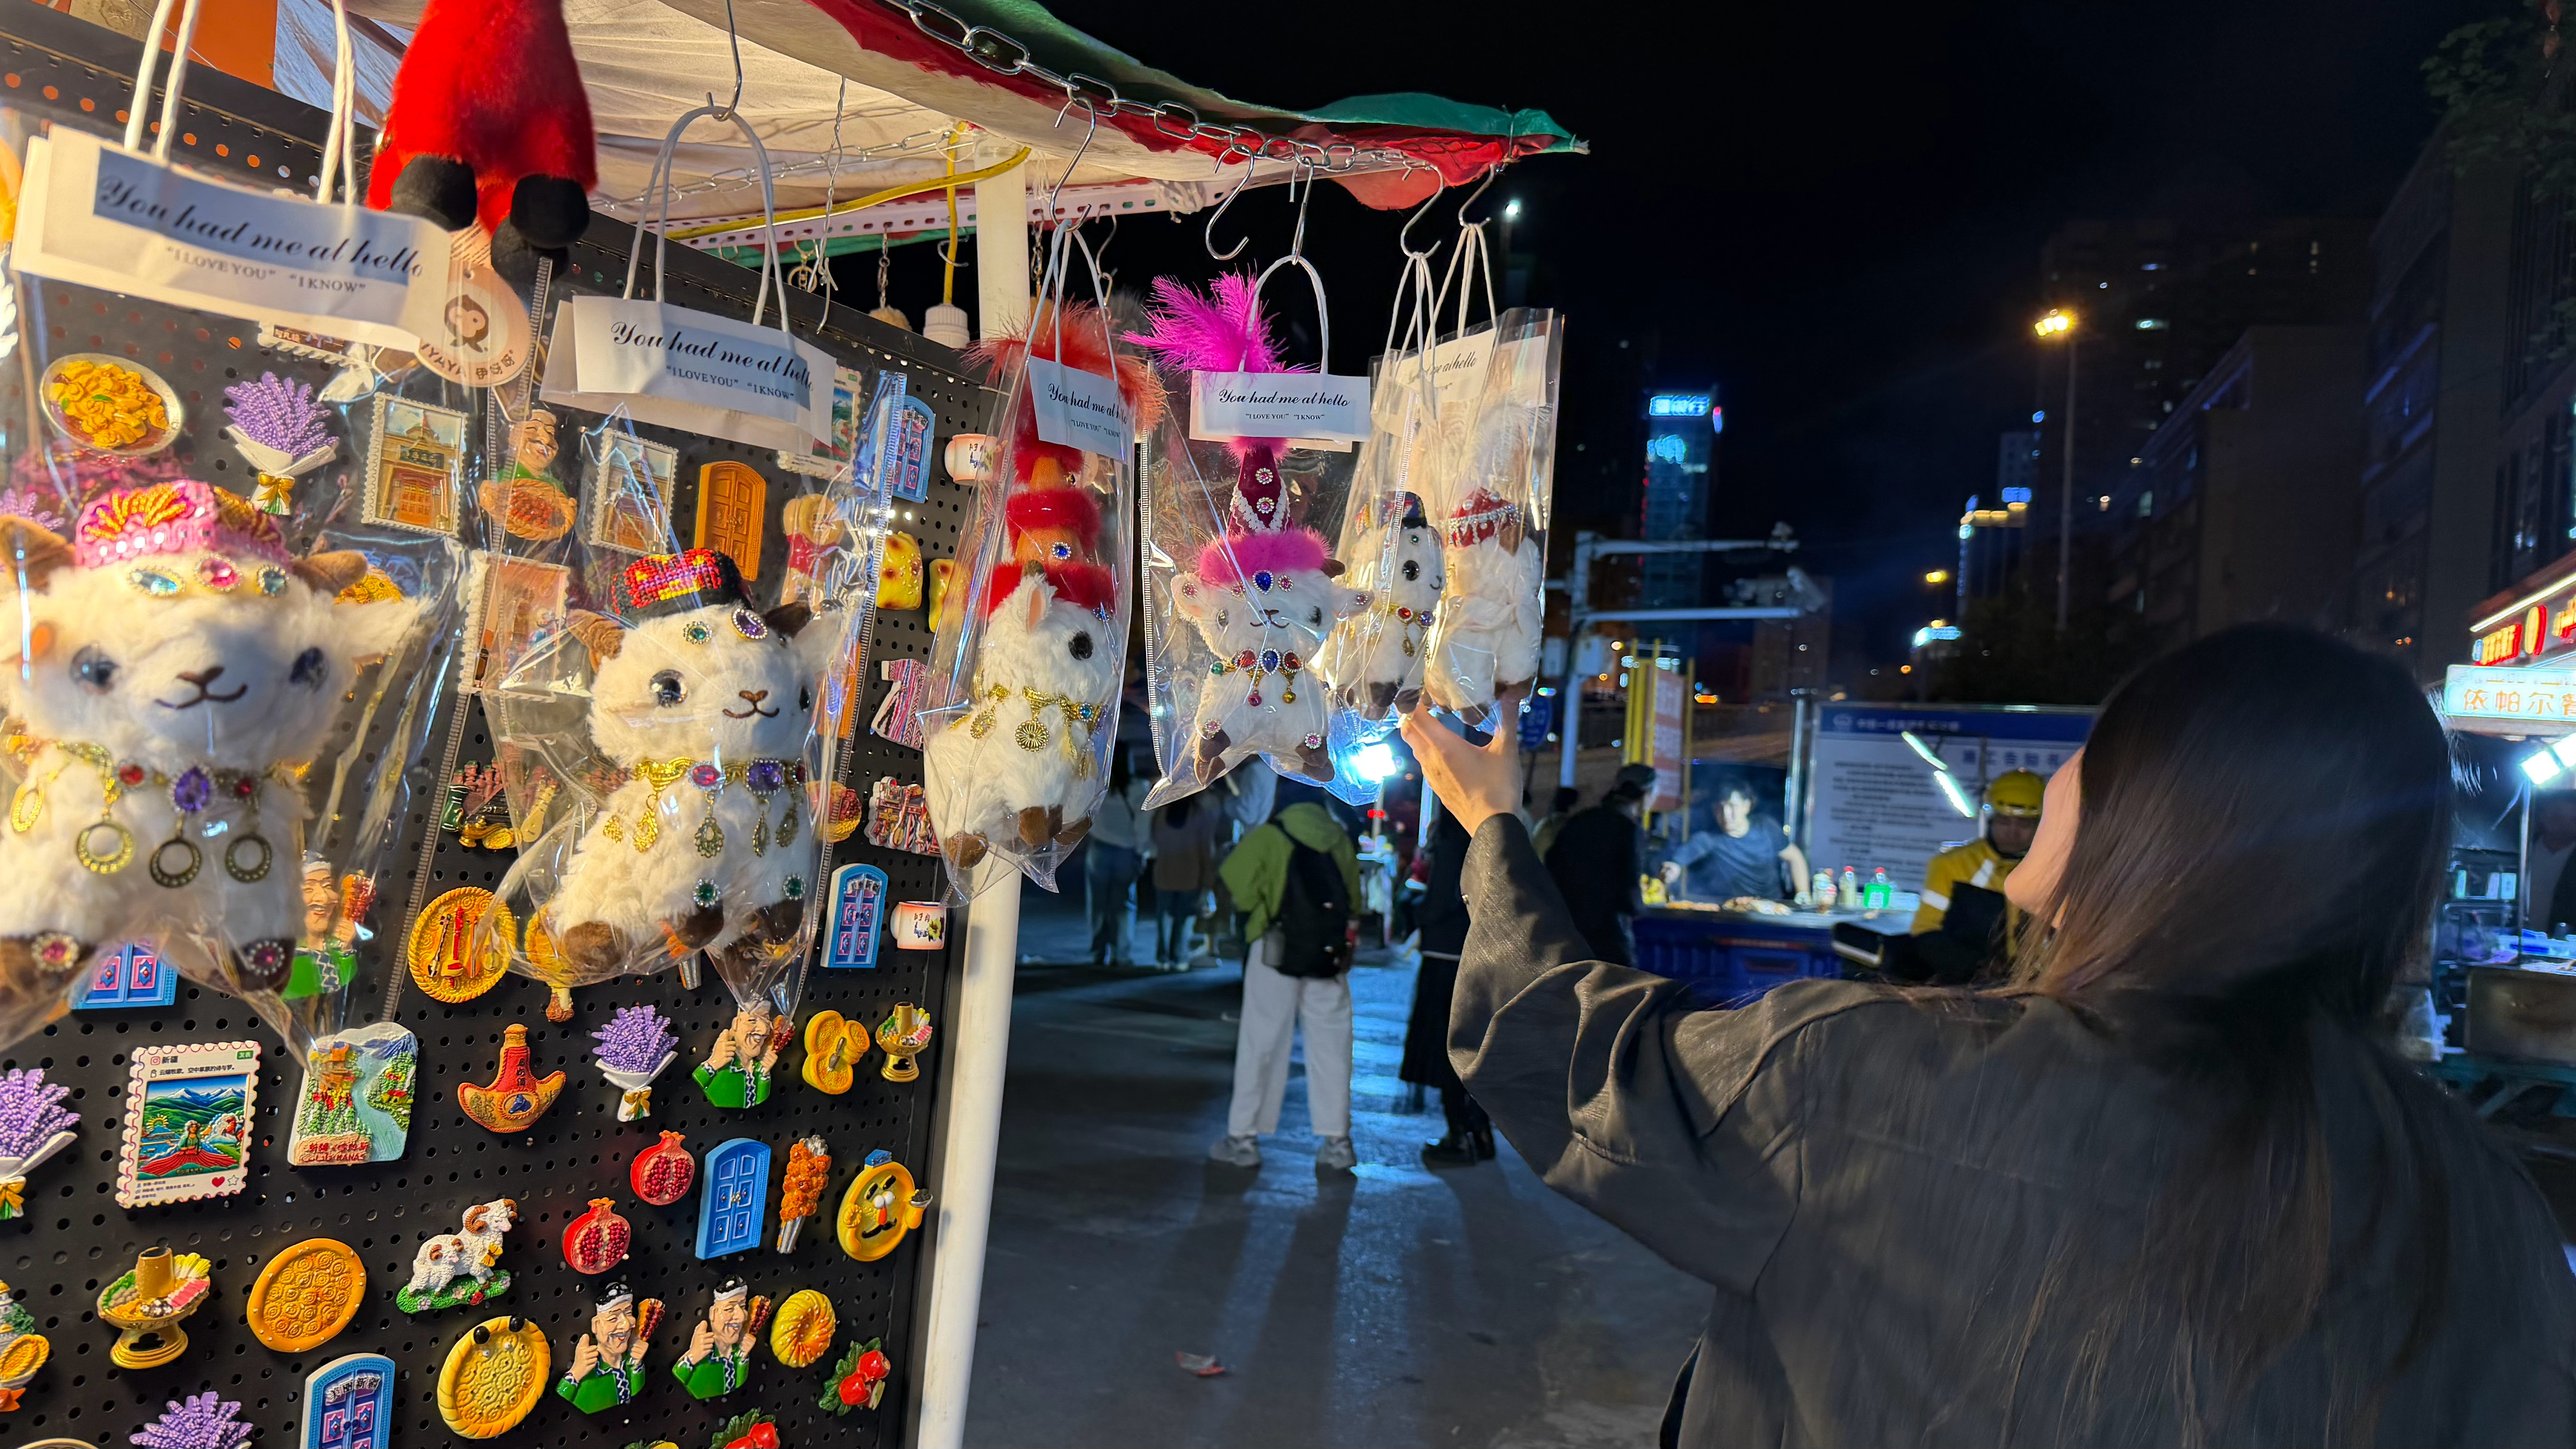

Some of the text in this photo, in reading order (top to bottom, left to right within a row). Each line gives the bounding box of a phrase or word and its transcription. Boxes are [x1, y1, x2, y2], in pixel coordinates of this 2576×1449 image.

[100, 175, 168, 220] You
[173, 205, 250, 242] had
[251, 234, 303, 255] me
[350, 240, 423, 277] hello
[184, 253, 229, 272] LOVE
[611, 321, 664, 346] You
[669, 331, 718, 359] had
[720, 351, 754, 367] me
[1452, 351, 1477, 369] hello
[679, 369, 708, 381] LOVE
[1048, 383, 1069, 405] You
[1071, 391, 1091, 409] had
[1092, 403, 1105, 414] me
[1219, 389, 1248, 403] You
[1249, 391, 1278, 404] had
[1279, 396, 1300, 404] me
[1318, 392, 1350, 407] hello
